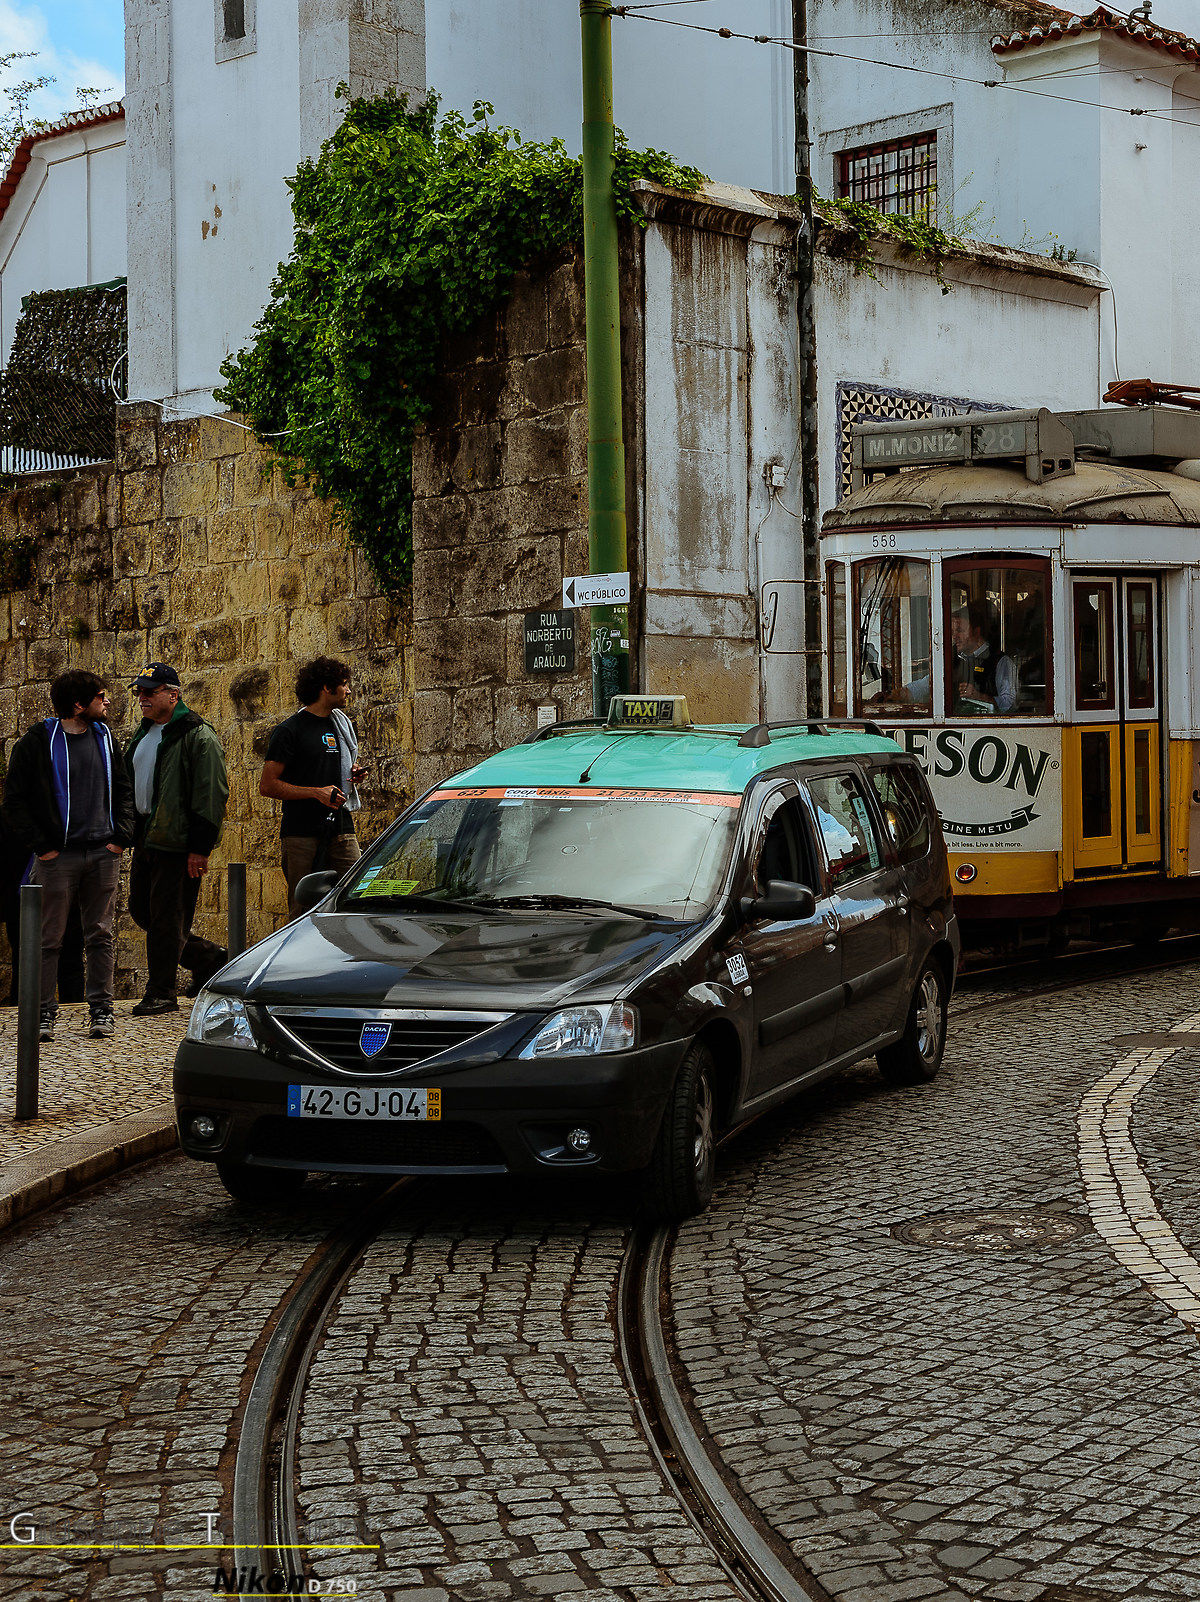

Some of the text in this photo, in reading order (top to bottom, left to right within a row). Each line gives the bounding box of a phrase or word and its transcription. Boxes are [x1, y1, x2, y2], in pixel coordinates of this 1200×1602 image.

[869, 425, 1016, 458] M.MONIZ 28
[872, 534, 896, 548] 558
[577, 588, 626, 601] WC PÚBLICO
[540, 614, 558, 626] RUA
[526, 628, 573, 643] NORBERTO
[544, 644, 554, 653] DE
[533, 653, 567, 669] ARAÚJO
[624, 701, 658, 717] TAXI
[942, 822, 1012, 834] SINE METU
[428, 1092, 440, 1101] 08
[428, 1107, 440, 1117] 08
